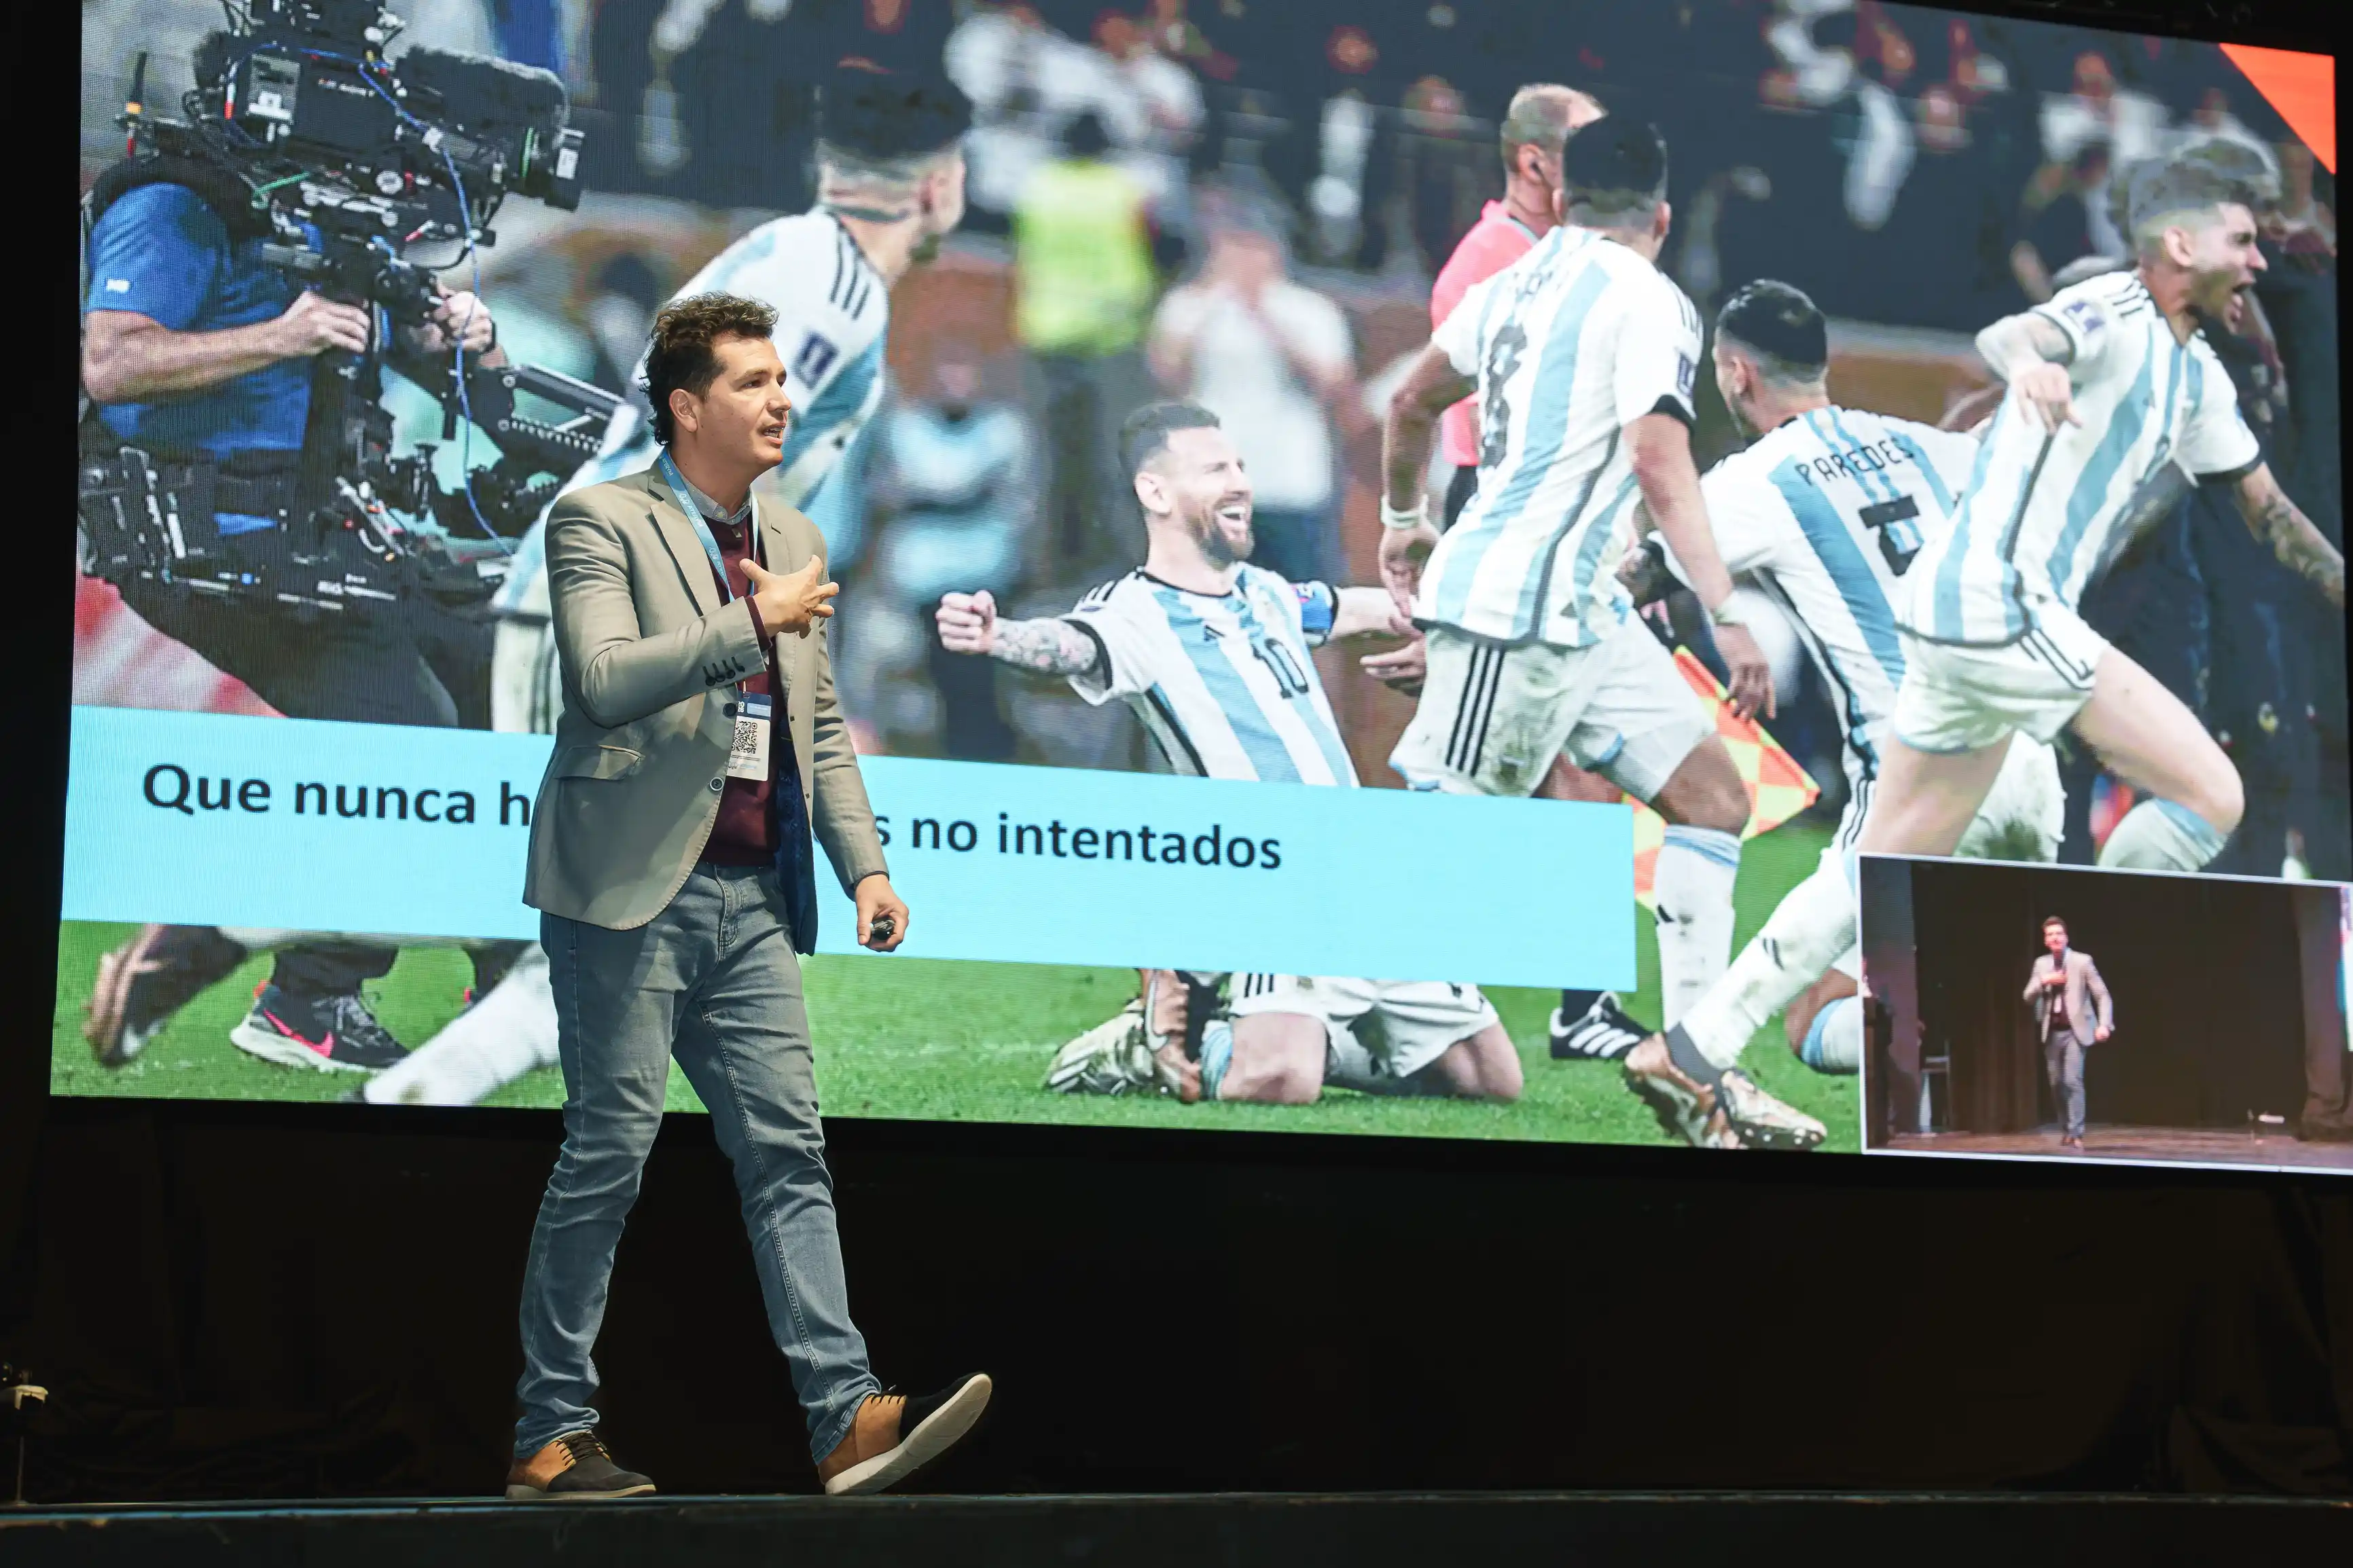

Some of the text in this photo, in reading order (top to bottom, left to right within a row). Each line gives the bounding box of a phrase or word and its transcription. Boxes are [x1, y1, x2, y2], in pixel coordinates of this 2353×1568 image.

[1794, 435, 1914, 487] PAREDES
[1252, 637, 1309, 699] 10
[143, 763, 271, 815] Que
[295, 782, 475, 824] nunca
[912, 818, 977, 852] no
[999, 812, 1282, 869] intentados
